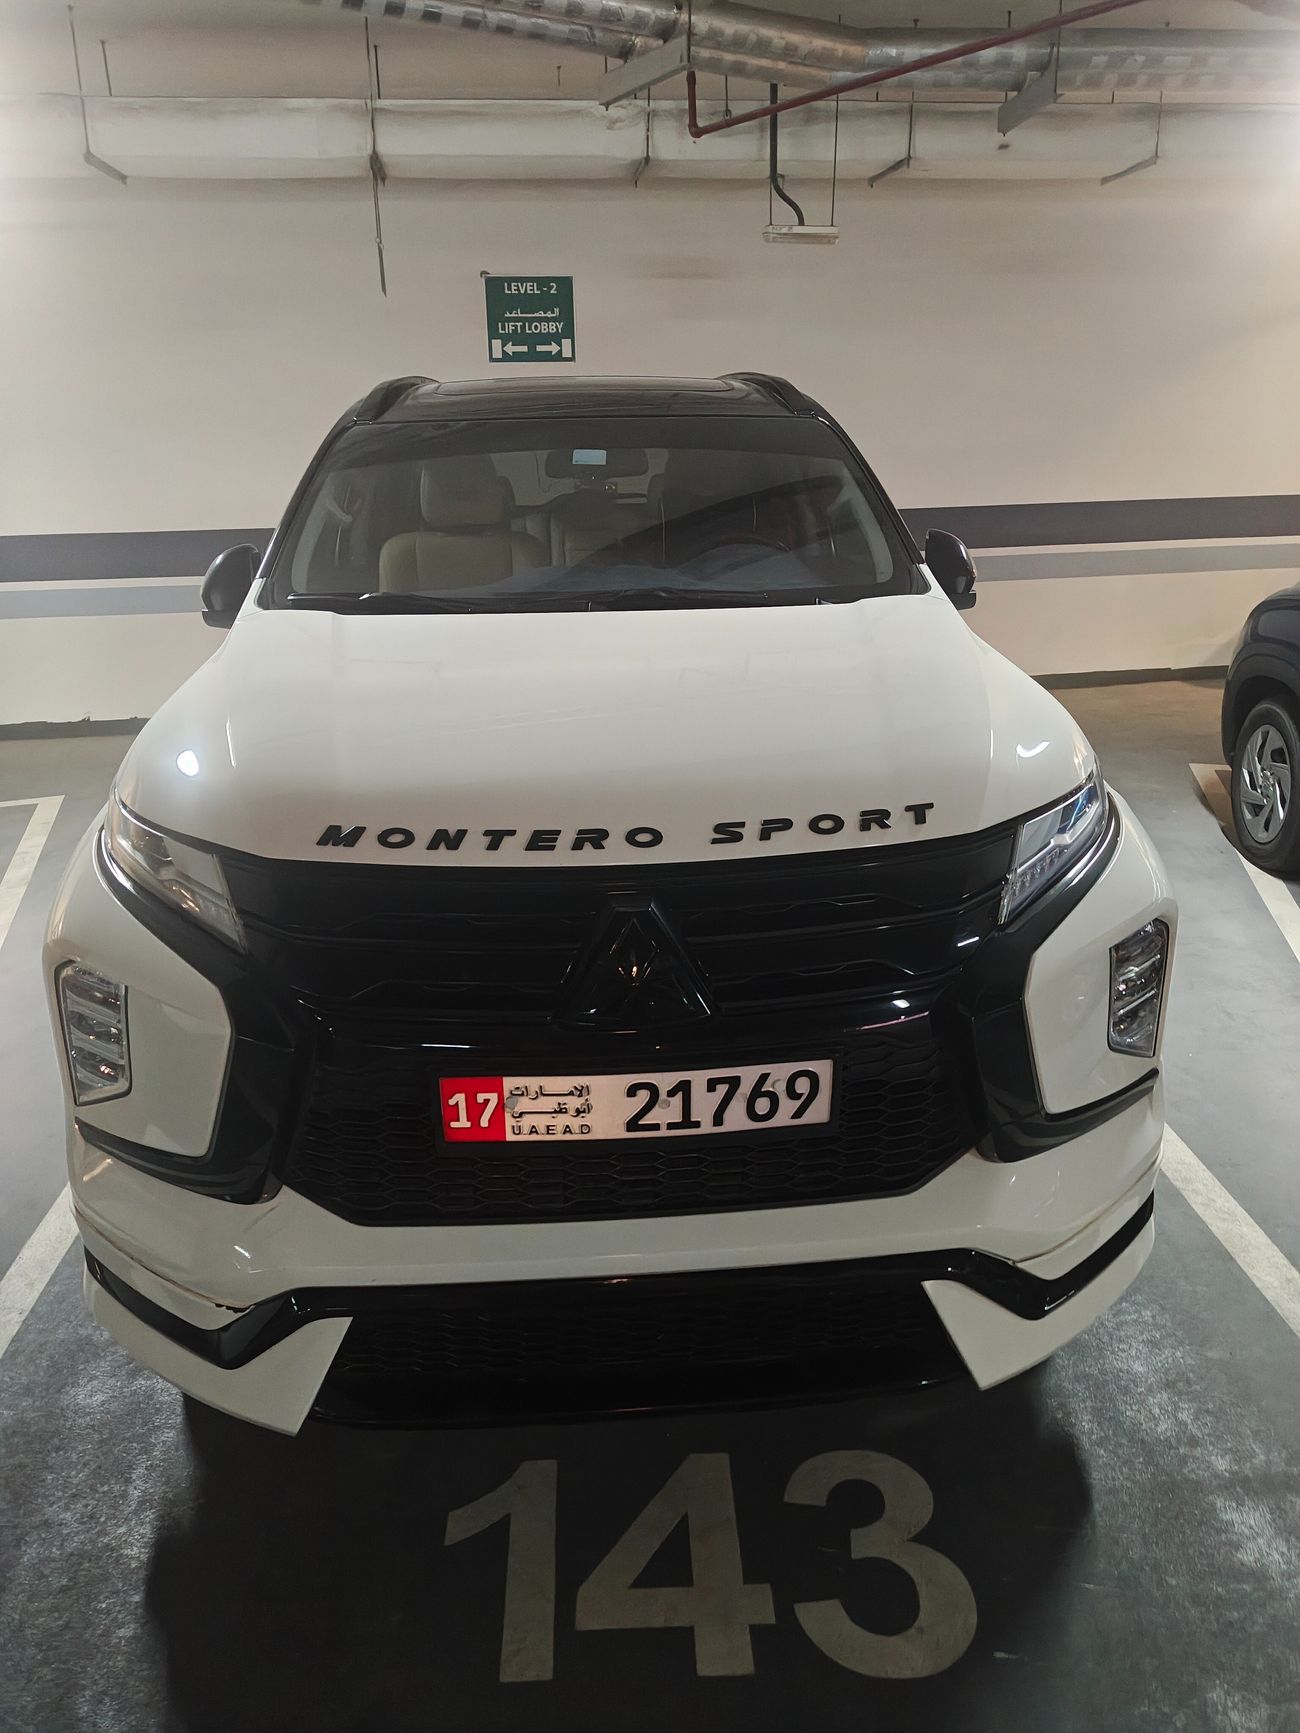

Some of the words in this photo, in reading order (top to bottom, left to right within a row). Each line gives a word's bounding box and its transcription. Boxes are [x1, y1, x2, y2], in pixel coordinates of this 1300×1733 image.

[504, 282, 540, 294] LEVEL
[549, 282, 557, 294] 2
[498, 322, 523, 334] LIFT
[525, 322, 563, 334] LOBBY
[315, 824, 664, 852] MONTERO
[710, 802, 935, 845] SPORT
[448, 1092, 499, 1128] 17
[625, 1069, 820, 1133] 21769
[444, 1449, 978, 1683] 143
